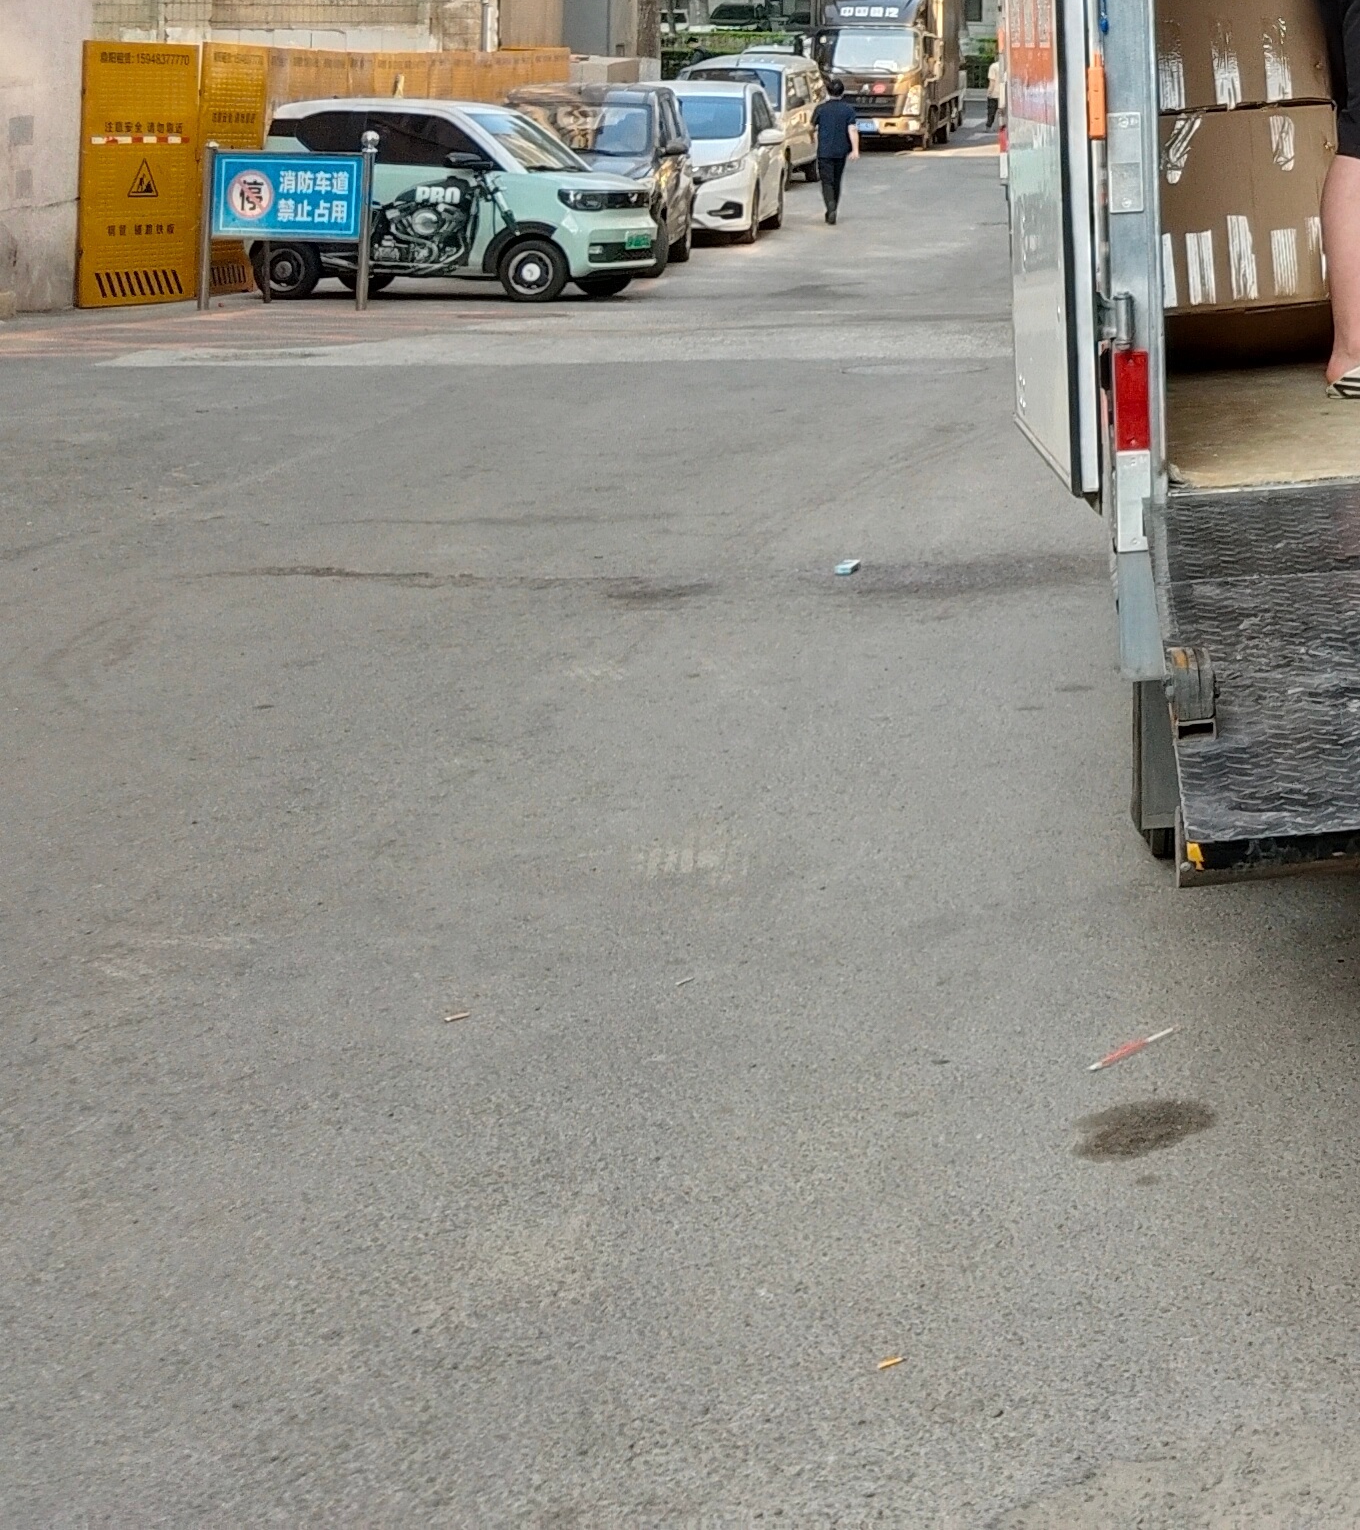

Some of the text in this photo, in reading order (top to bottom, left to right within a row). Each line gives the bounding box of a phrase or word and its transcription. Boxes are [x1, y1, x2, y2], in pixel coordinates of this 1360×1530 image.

[278, 170, 350, 195] 消防车道
[415, 185, 461, 204] PRO
[277, 199, 349, 224] 禁止占用
